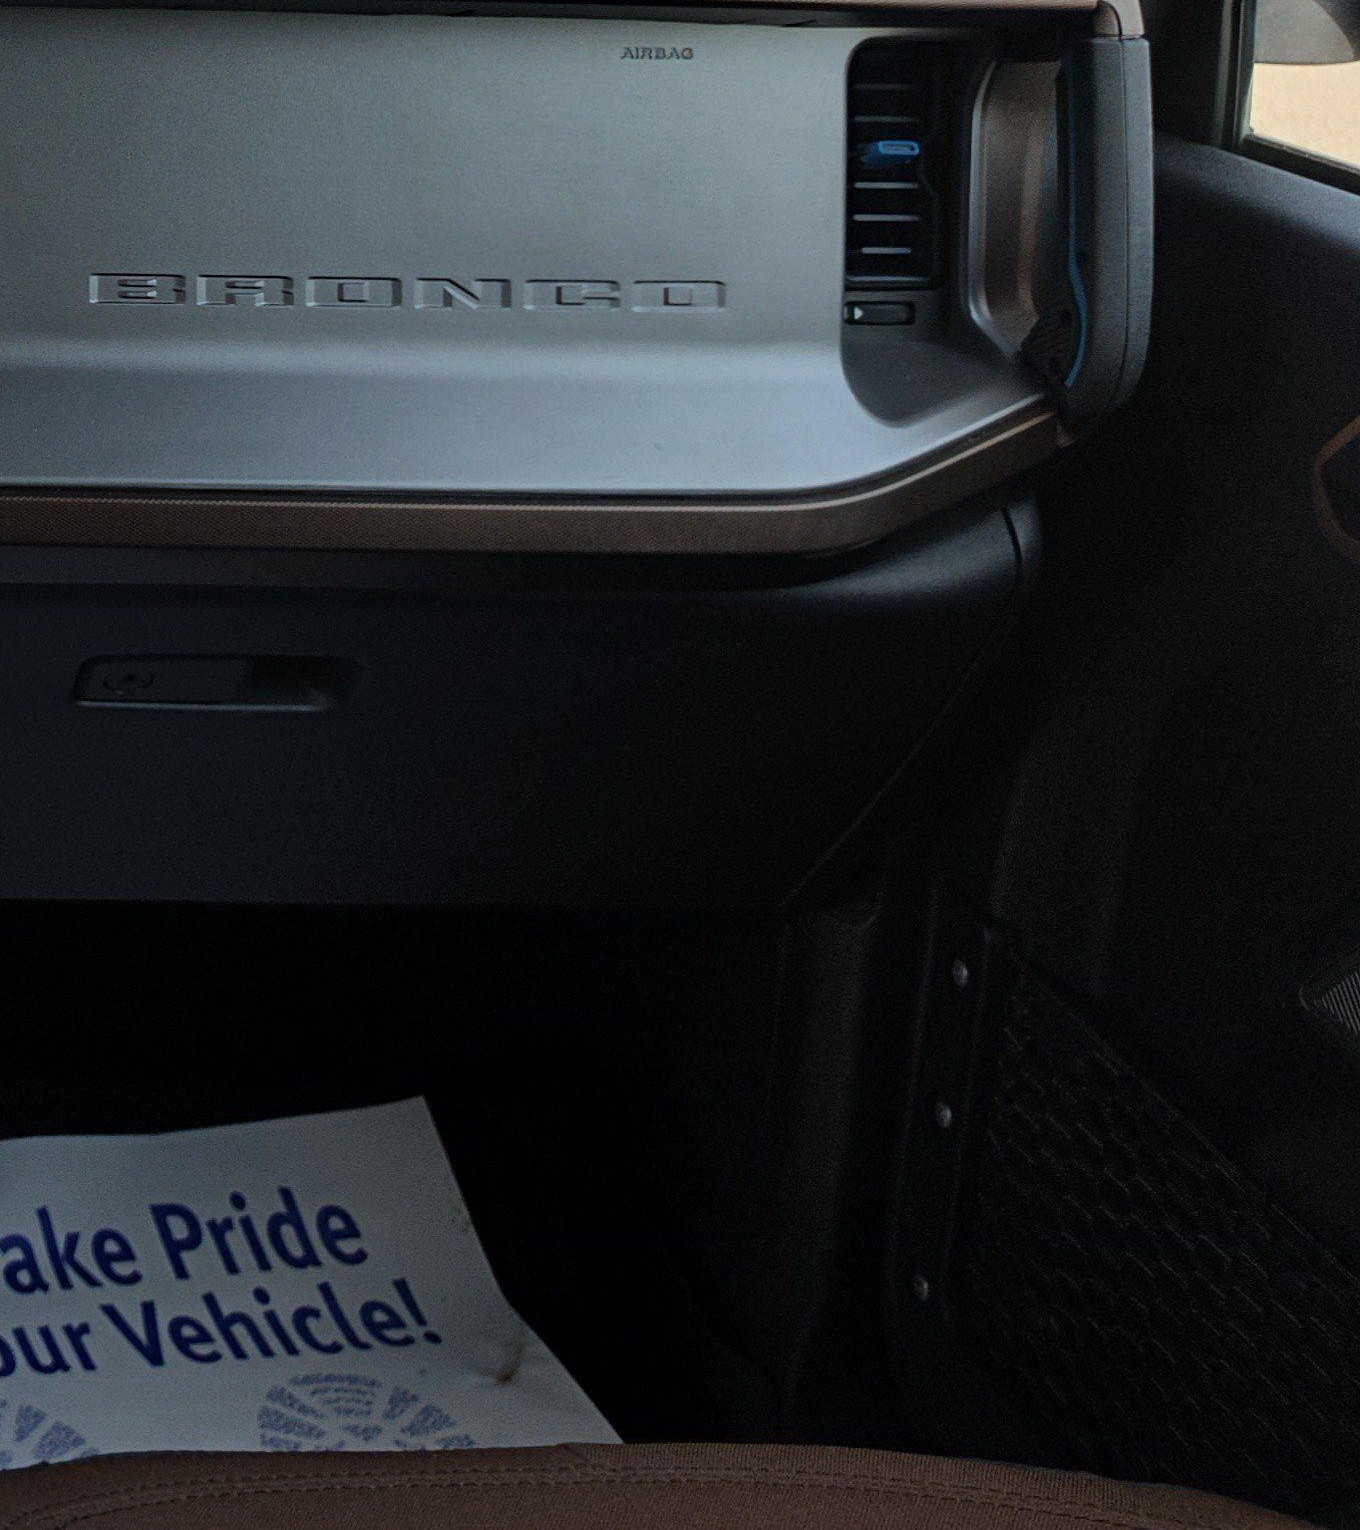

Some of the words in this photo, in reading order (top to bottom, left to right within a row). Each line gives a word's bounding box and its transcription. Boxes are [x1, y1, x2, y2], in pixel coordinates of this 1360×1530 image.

[620, 46, 695, 61] AIRBAG
[88, 272, 728, 315] BRONCO
[148, 1186, 370, 1280] Pride
[100, 1278, 443, 1368] Vehicle!
